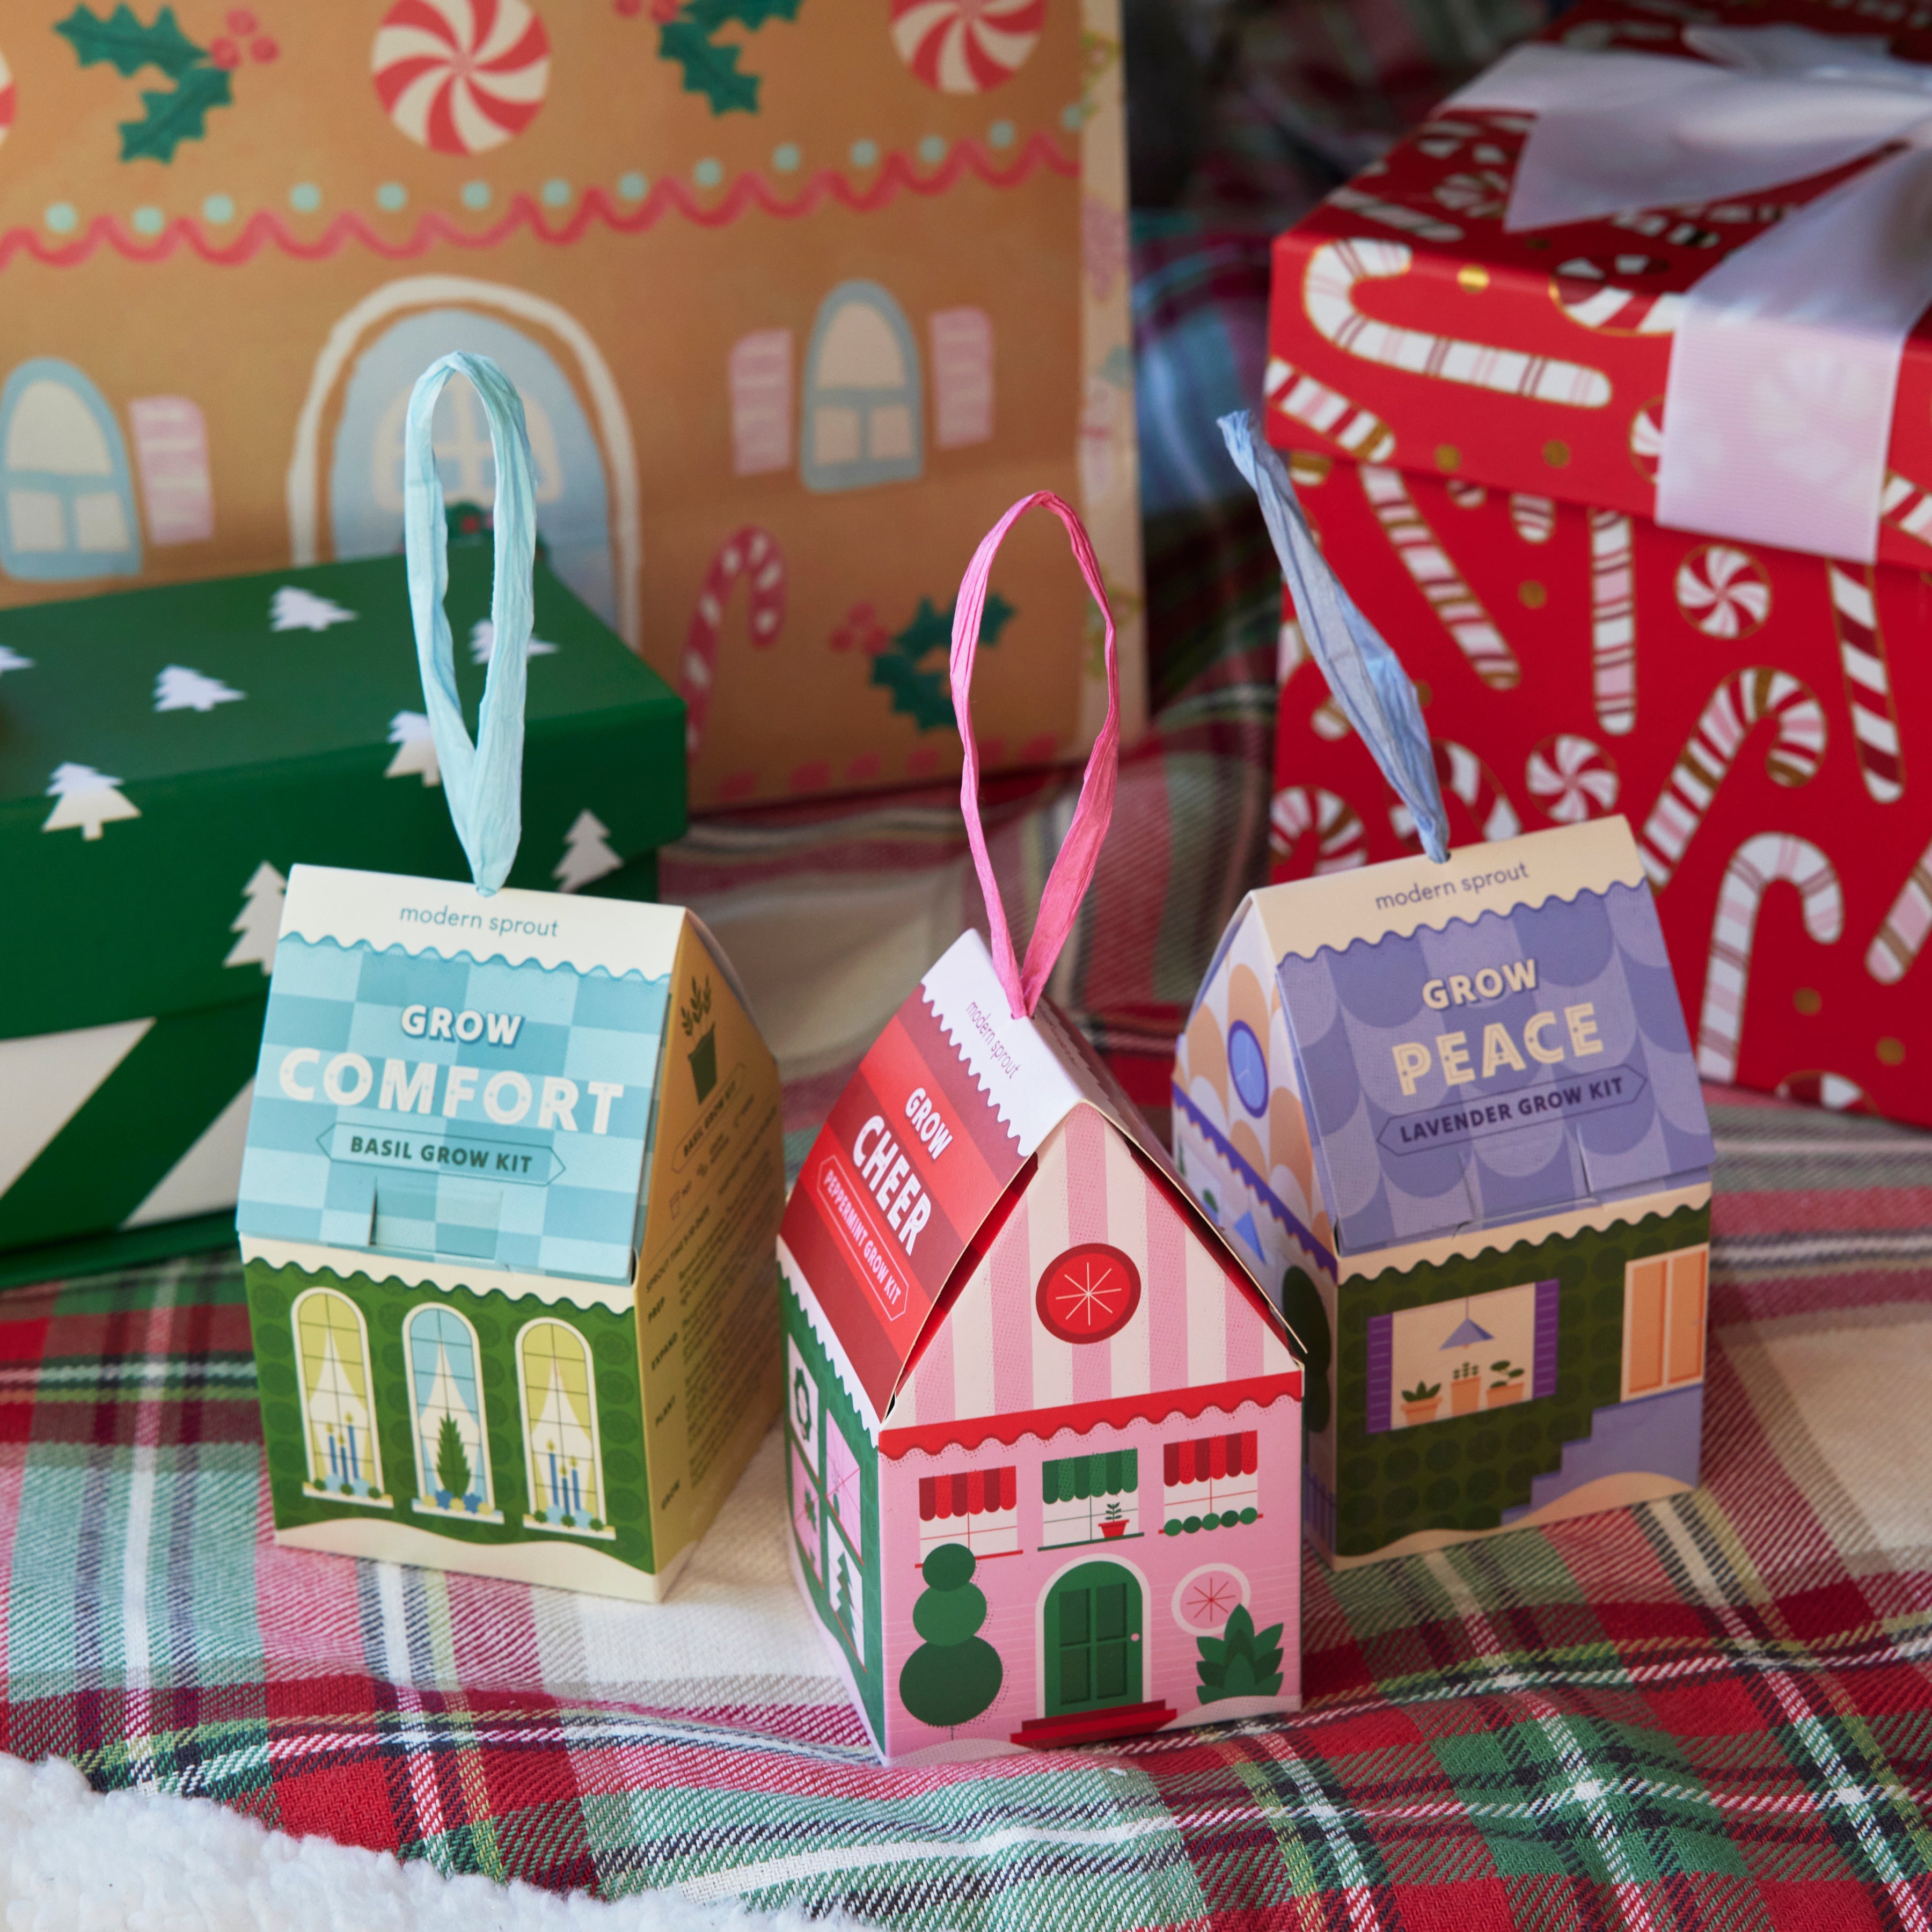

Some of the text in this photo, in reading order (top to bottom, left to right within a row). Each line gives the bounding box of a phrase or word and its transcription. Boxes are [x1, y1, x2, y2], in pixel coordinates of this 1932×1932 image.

[399, 905, 559, 937] modern sprout
[1375, 861, 1529, 911] modern sprout
[1422, 958, 1538, 1011] GROW
[400, 1004, 524, 1046] GROW
[965, 1001, 1021, 1079] modern sprout
[1392, 1002, 1604, 1096] PEACE
[279, 1047, 624, 1135] COMFORT
[904, 1087, 954, 1161] GROW
[1400, 1077, 1624, 1144] LAVENDER GROW KIT
[350, 1136, 533, 1174] BASIL GROW KIT
[852, 1115, 933, 1257] CHEER
[823, 1169, 902, 1306] PEPPERMINT GROW KIT
